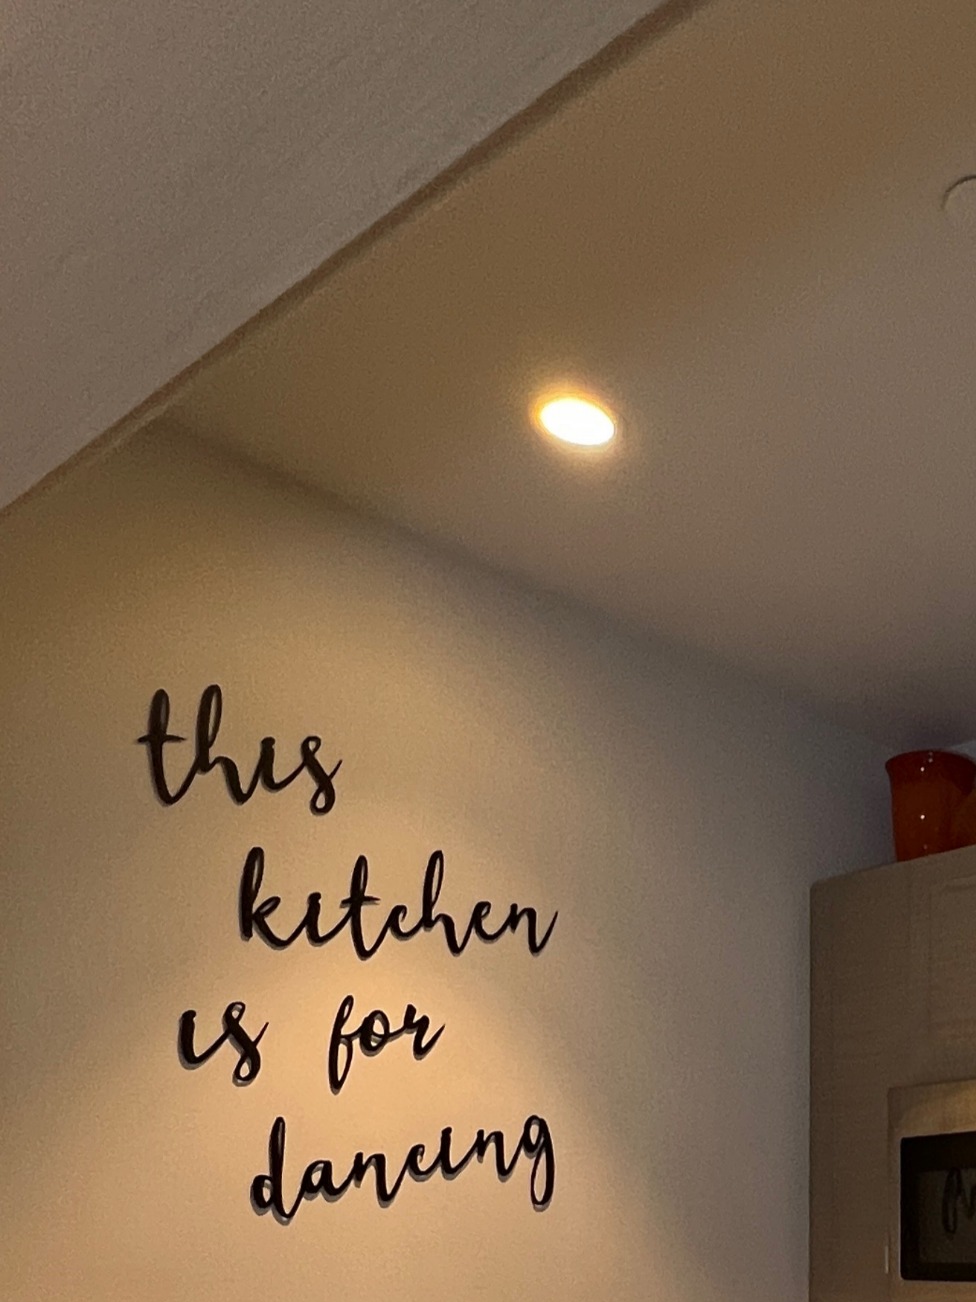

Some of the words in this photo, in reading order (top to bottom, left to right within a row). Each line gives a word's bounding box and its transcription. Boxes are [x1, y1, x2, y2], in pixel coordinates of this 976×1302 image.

[136, 684, 343, 816] this
[238, 846, 560, 961] kitchen
[177, 1001, 270, 1087] is
[327, 994, 446, 1095] for
[249, 1114, 556, 1225] dancing
